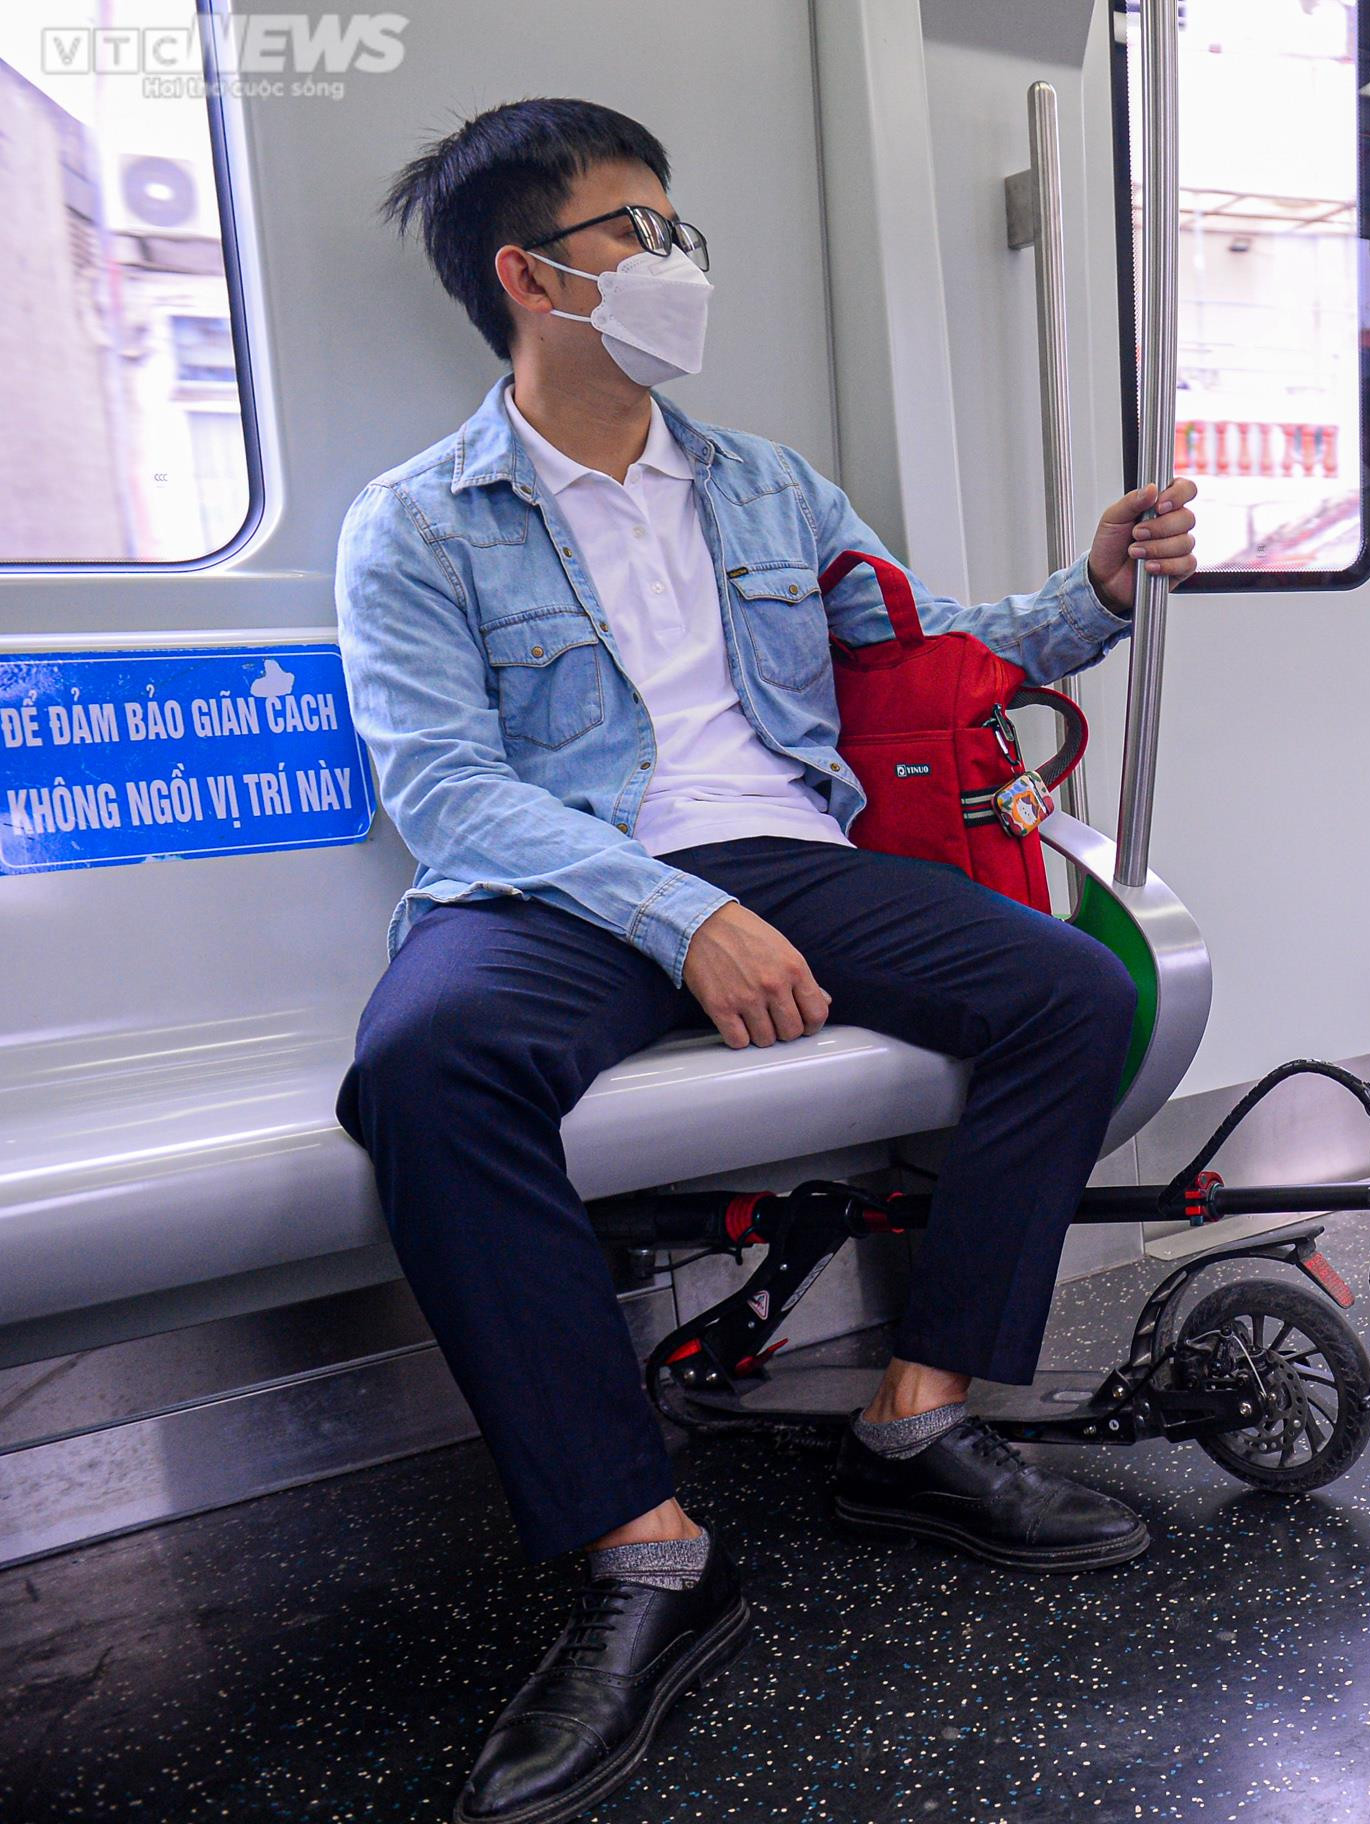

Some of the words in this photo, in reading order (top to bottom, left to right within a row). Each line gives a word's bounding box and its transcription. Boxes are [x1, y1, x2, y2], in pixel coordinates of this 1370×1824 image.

[0, 690, 43, 748] ĐỂ
[49, 687, 120, 746] ĐẢM
[124, 684, 185, 741] BẢO
[191, 690, 260, 738] GIÃN
[6, 776, 121, 835] KHÔNG
[126, 763, 203, 827] NGỒI
[206, 775, 241, 828] VỊ
[242, 762, 292, 816] TRÍ
[295, 759, 352, 813] NÀY
